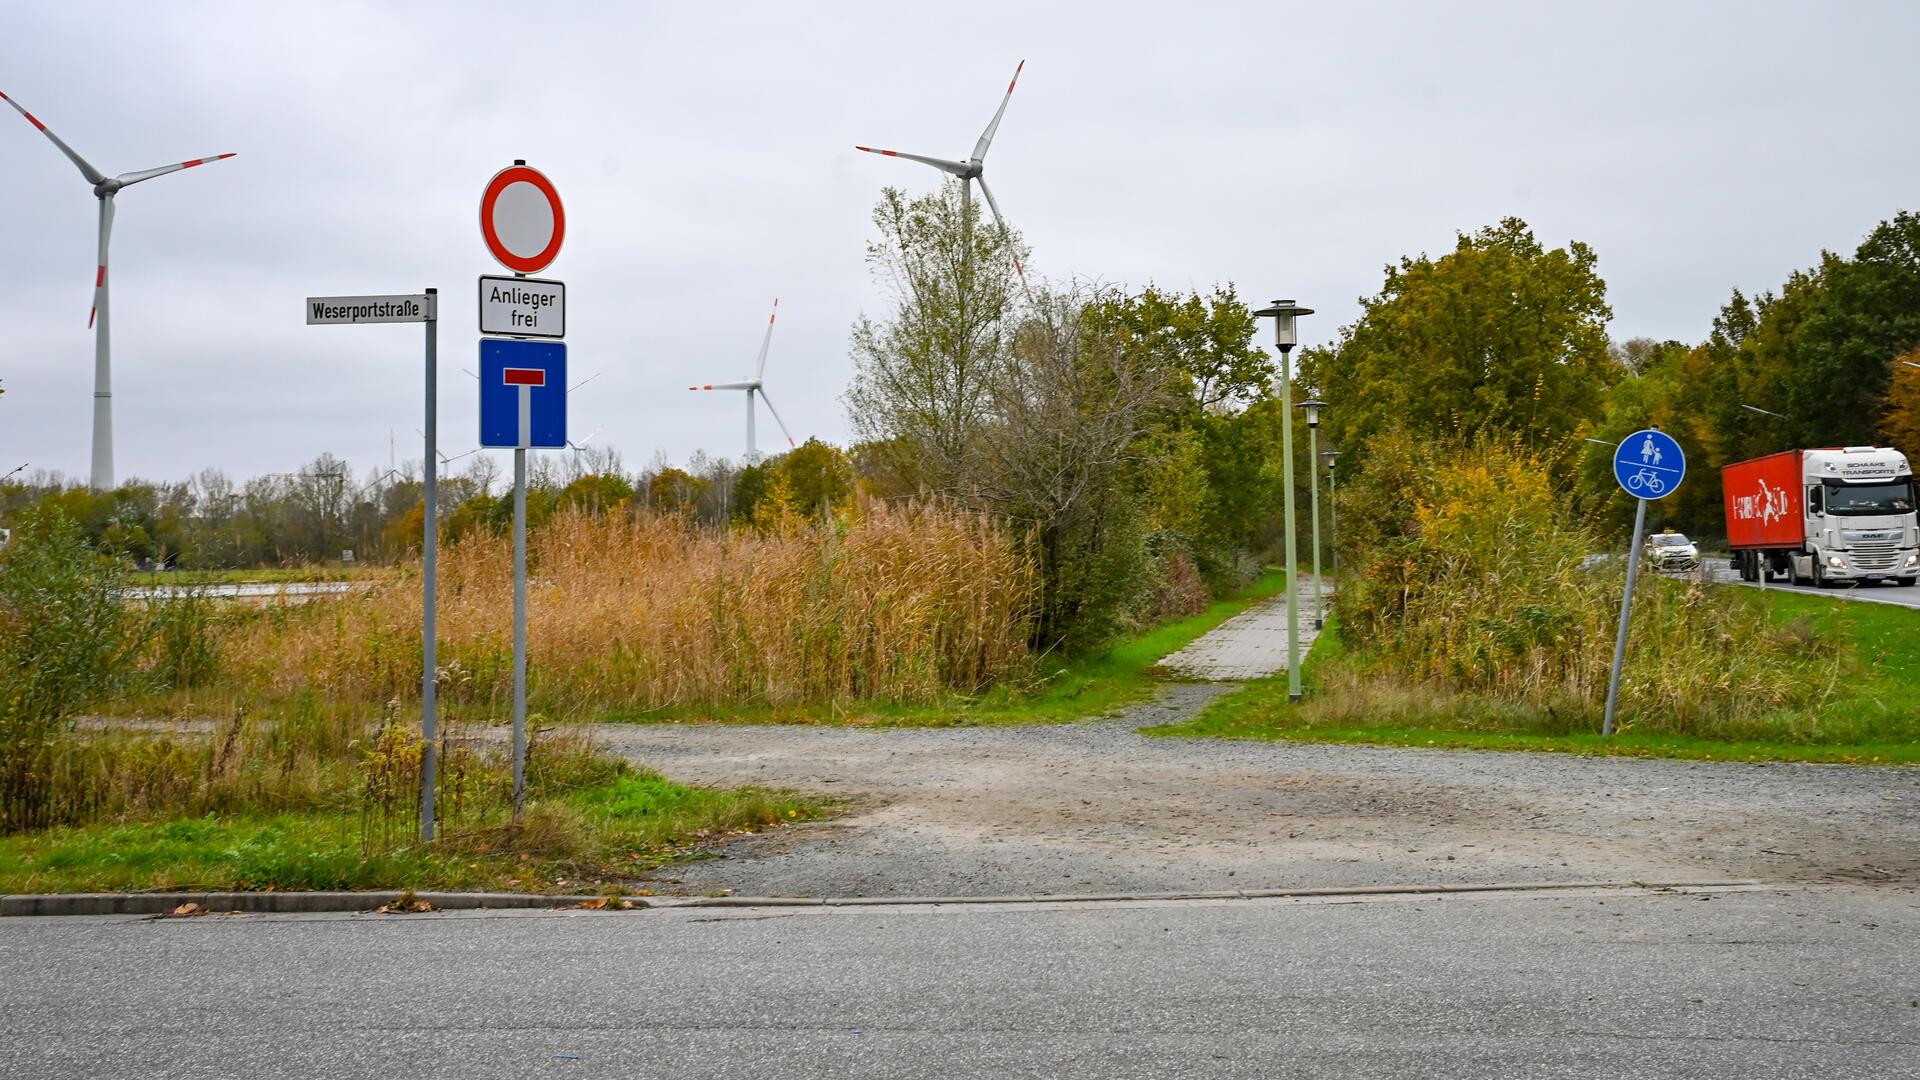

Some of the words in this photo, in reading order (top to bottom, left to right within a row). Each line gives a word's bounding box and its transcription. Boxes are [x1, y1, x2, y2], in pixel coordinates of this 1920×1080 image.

[490, 286, 556, 310] Anlieger
[313, 300, 419, 322] Weserportstraße
[511, 310, 538, 327] frei
